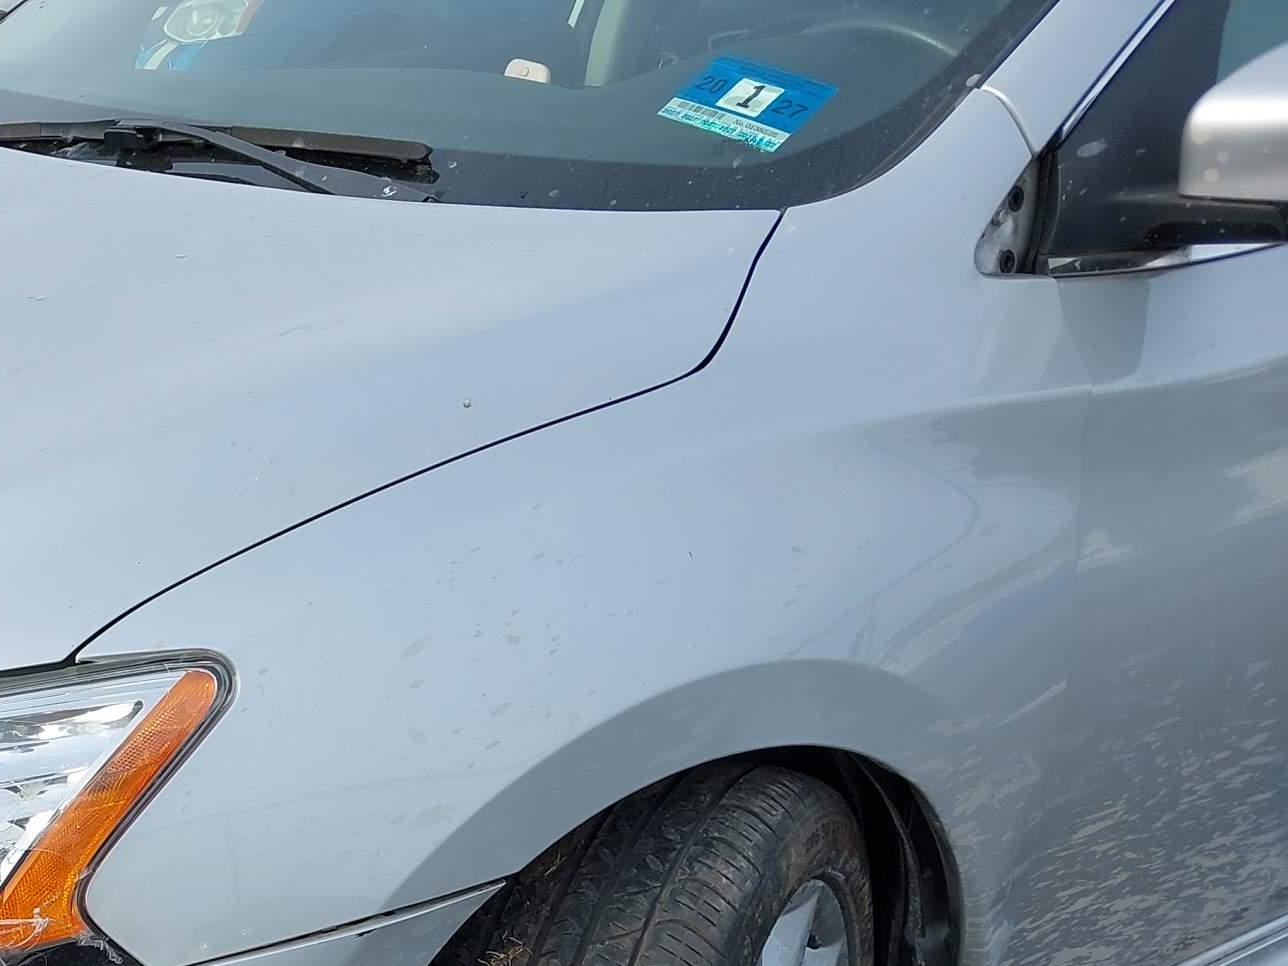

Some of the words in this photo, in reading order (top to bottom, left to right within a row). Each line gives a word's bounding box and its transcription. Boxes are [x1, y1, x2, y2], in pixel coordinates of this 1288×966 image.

[696, 76, 728, 94] 20
[736, 85, 765, 109] 1
[773, 101, 808, 118] 27
